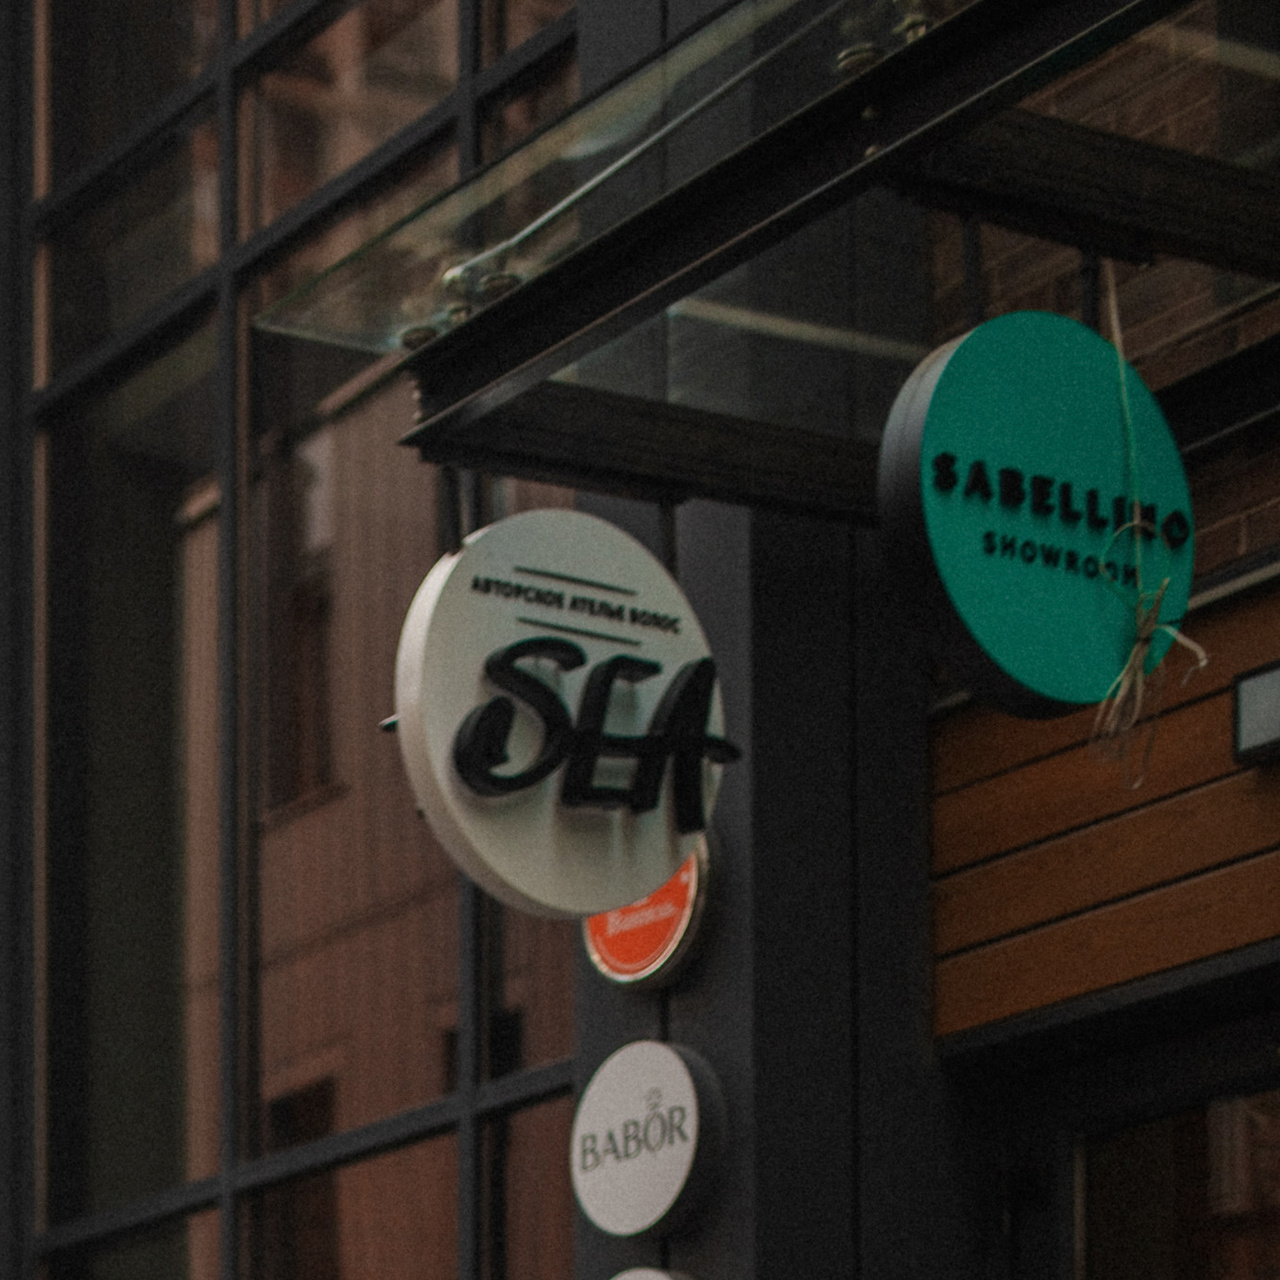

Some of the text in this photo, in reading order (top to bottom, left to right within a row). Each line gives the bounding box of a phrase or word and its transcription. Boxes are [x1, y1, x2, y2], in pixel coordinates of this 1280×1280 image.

[981, 530, 1138, 587] SHOWROOM
[471, 575, 565, 610] АВТОРСКОЕ
[453, 636, 742, 835] SEA
